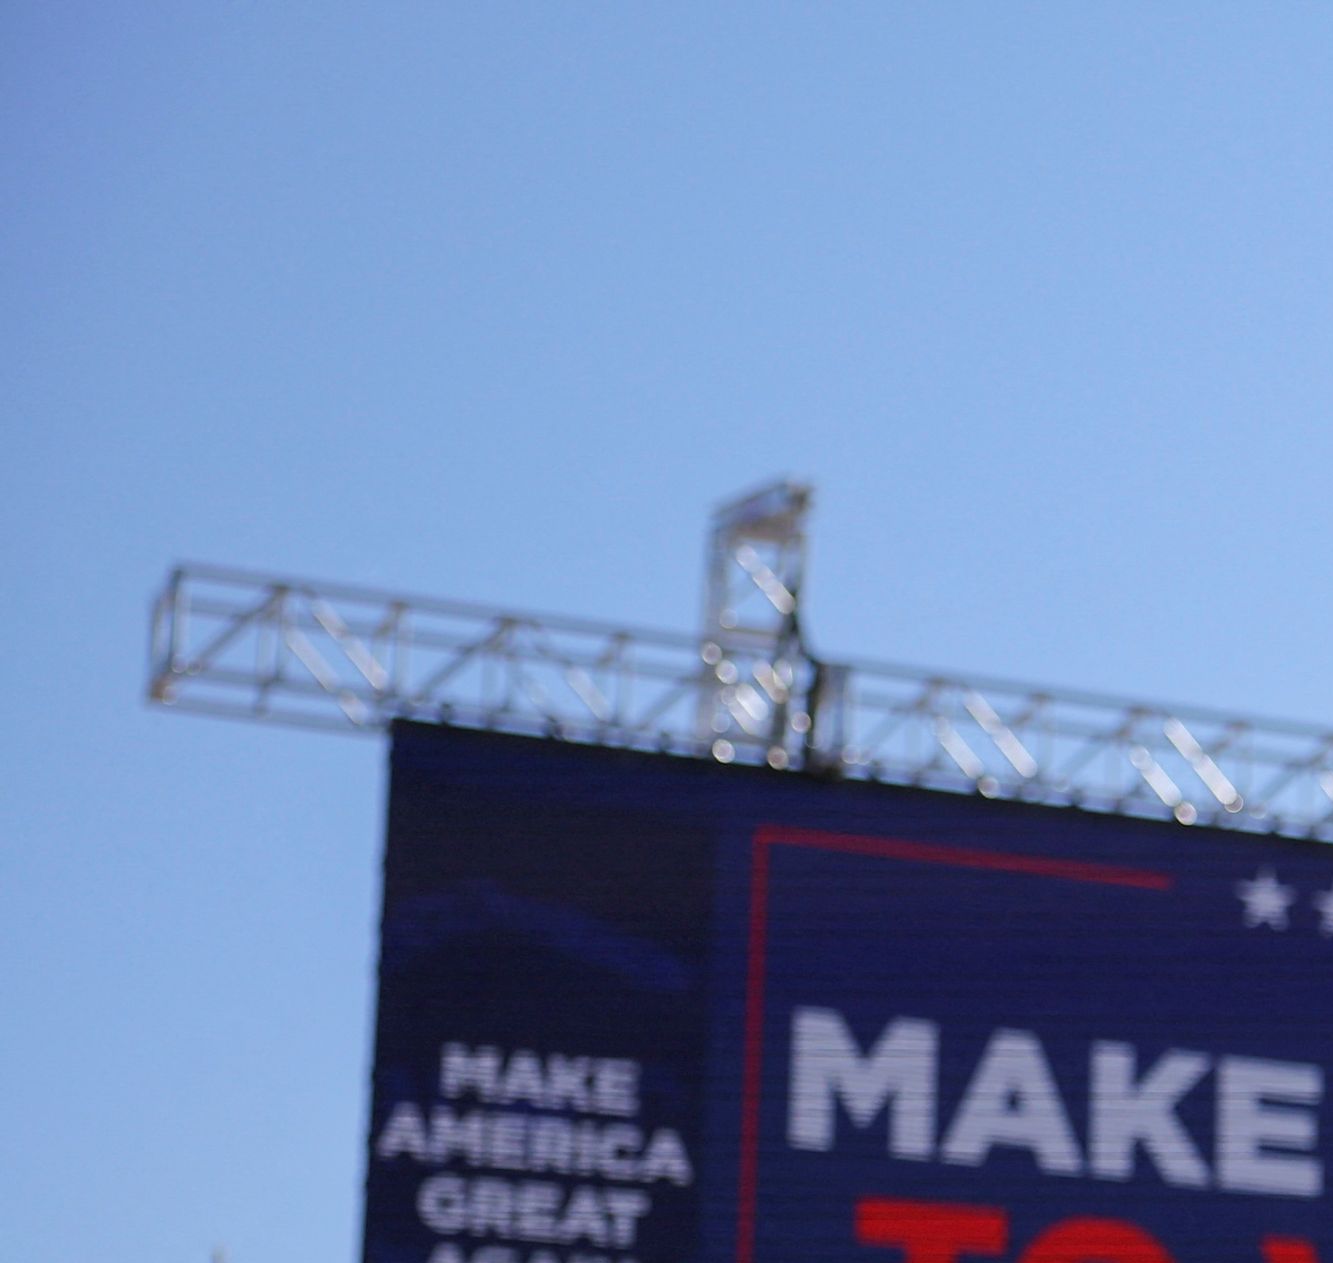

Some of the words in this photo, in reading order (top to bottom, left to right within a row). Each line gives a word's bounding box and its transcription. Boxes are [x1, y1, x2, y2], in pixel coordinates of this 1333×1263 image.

[440, 1041, 642, 1117] MAKE
[787, 1008, 1323, 1195] MAKE
[381, 1101, 693, 1186] AMERICA
[416, 1172, 651, 1249] GREAT
